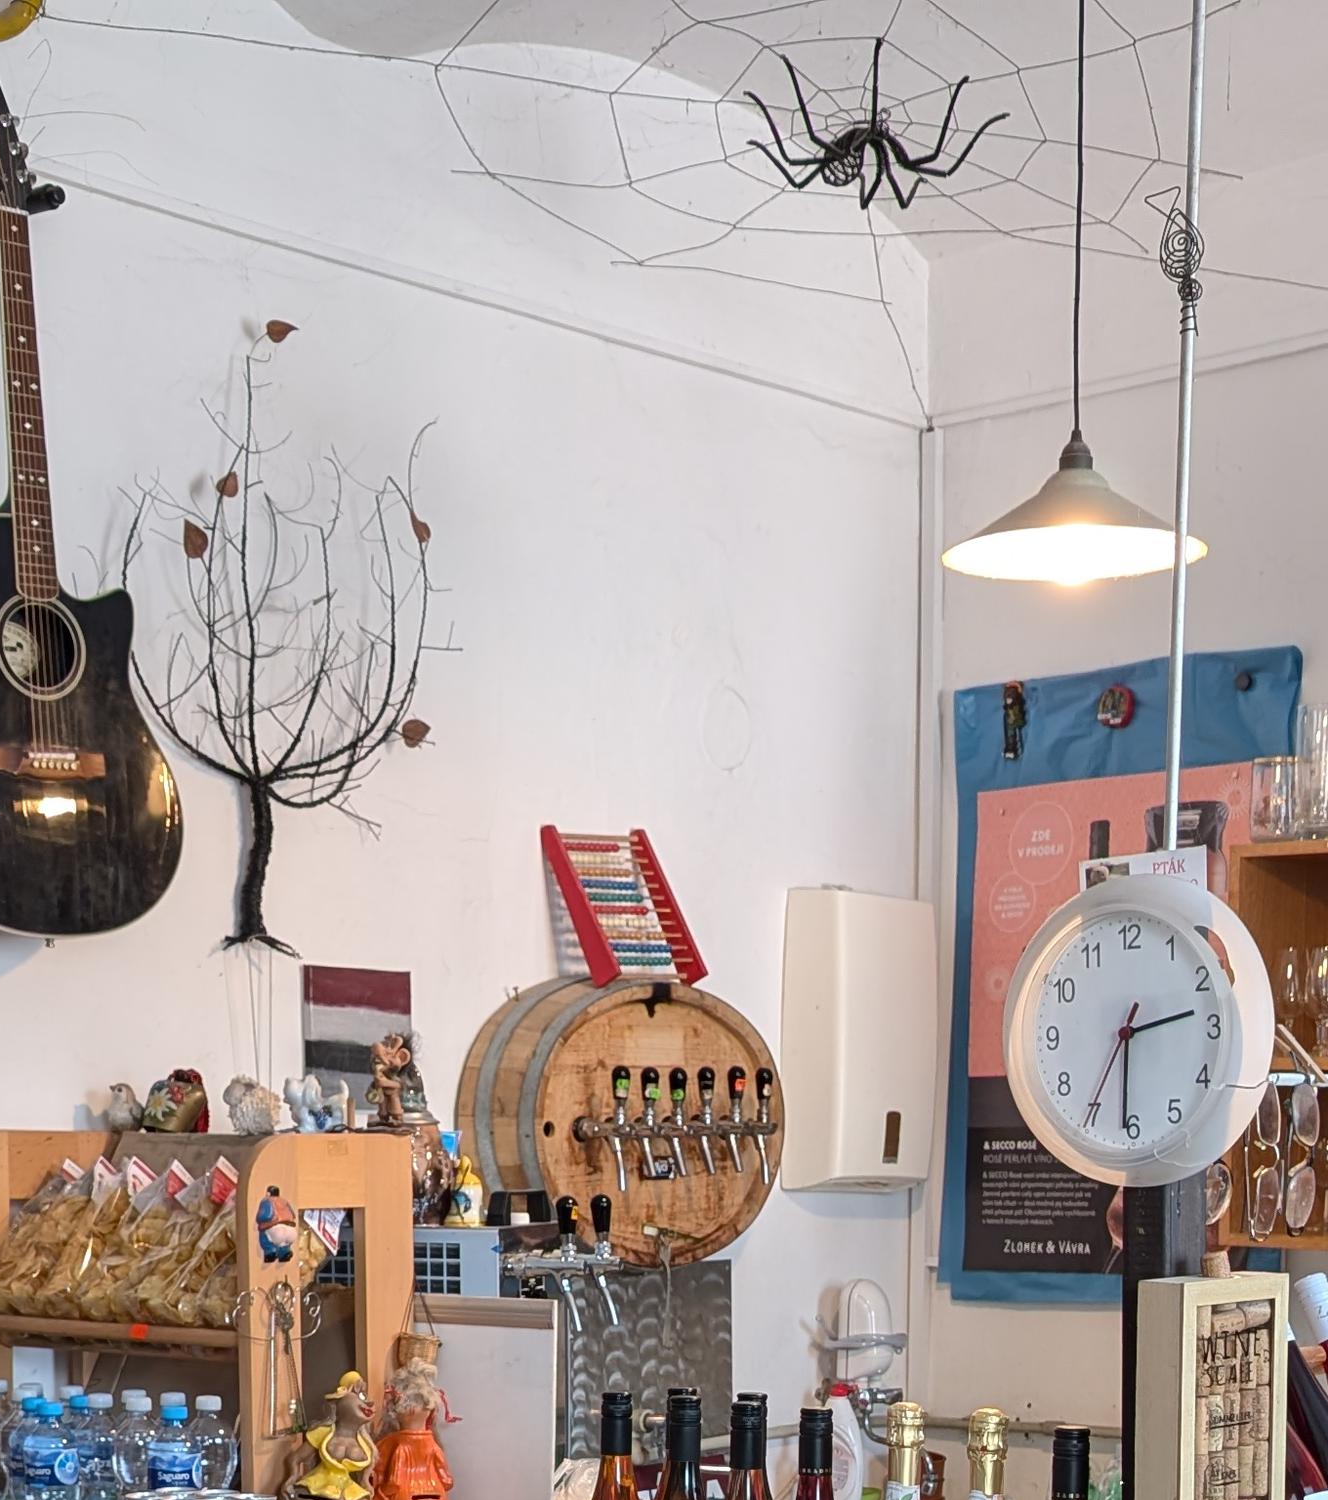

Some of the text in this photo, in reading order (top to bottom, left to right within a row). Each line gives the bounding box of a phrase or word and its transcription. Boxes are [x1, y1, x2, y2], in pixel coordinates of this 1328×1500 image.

[1118, 924, 1142, 950] 12
[1166, 935, 1175, 961] 1
[1081, 942, 1101, 969] 11
[1053, 977, 1075, 1004] 10
[1195, 966, 1210, 992] 2
[1046, 1025, 1060, 1051] 9
[1206, 1014, 1221, 1040] 3
[1057, 1071, 1071, 1097] 8
[1195, 1063, 1211, 1090] 4
[1088, 1101, 1102, 1127] 7
[1167, 1099, 1182, 1125] 5
[1126, 1115, 1141, 1140] 6
[1202, 1331, 1261, 1364] WINE
